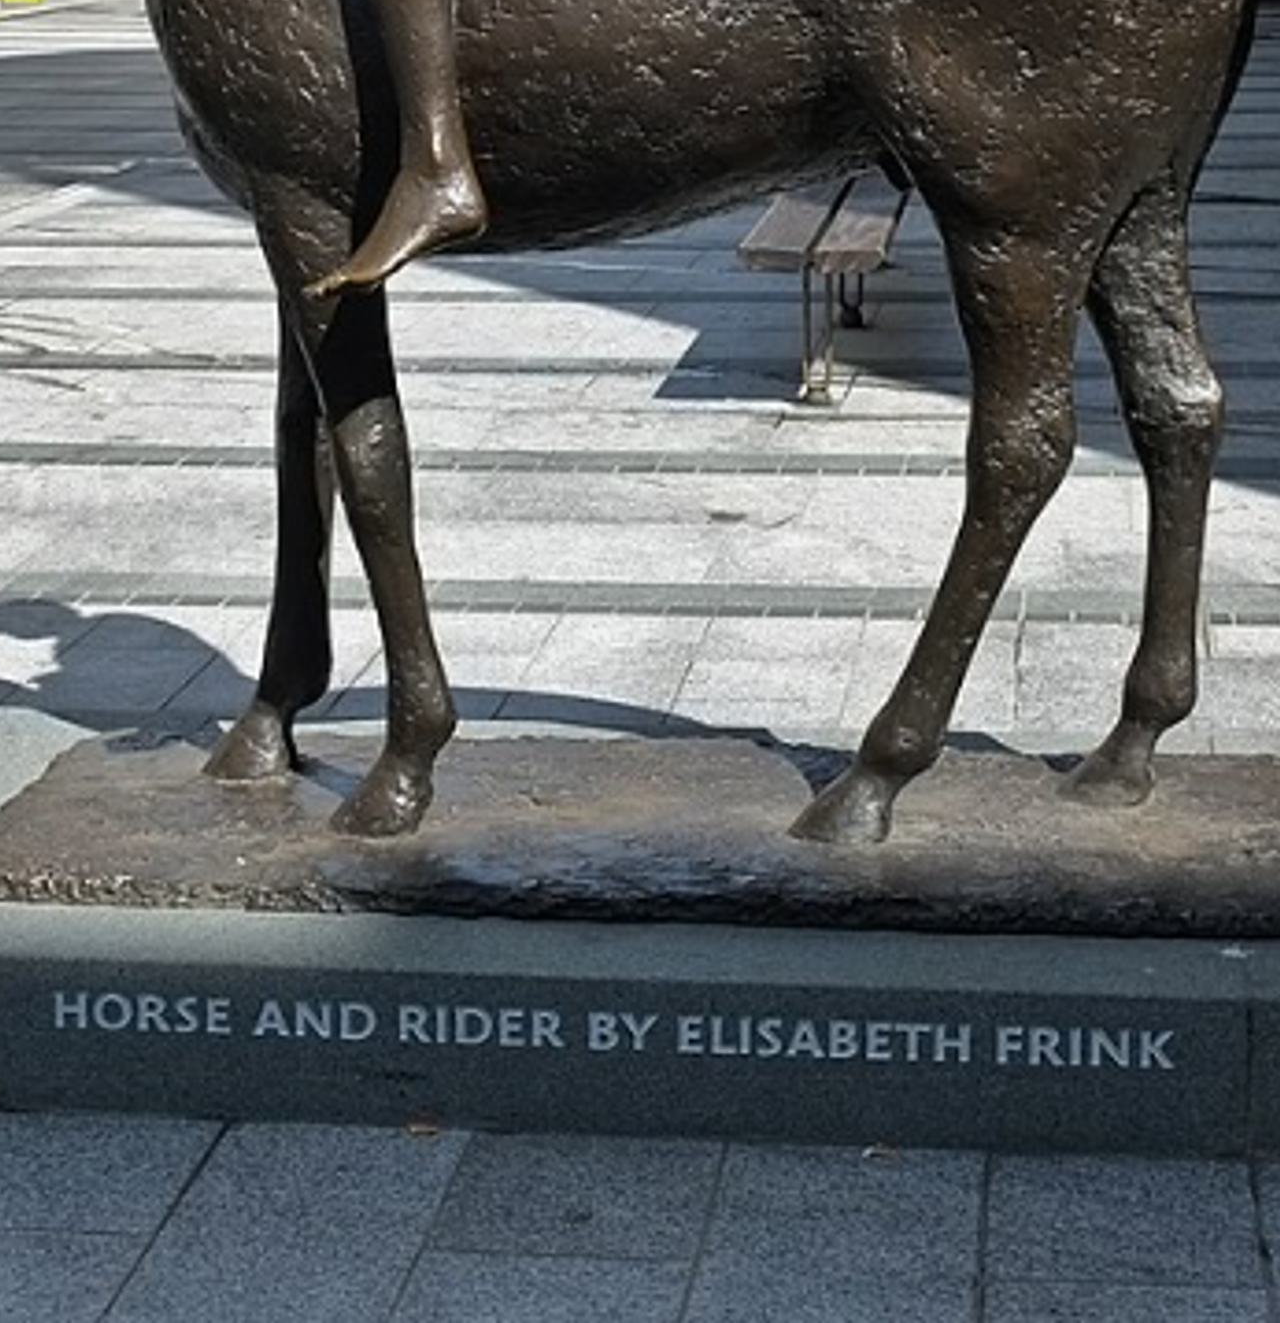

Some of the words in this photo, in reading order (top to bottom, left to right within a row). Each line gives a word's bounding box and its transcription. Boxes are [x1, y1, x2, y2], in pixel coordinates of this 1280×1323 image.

[53, 990, 231, 1034] HORSE
[251, 1000, 378, 1041] AND
[398, 1004, 565, 1048] RIDER
[587, 1011, 658, 1052] BY
[676, 1015, 972, 1063] ELISABETH
[995, 1024, 1176, 1070] FRINK
